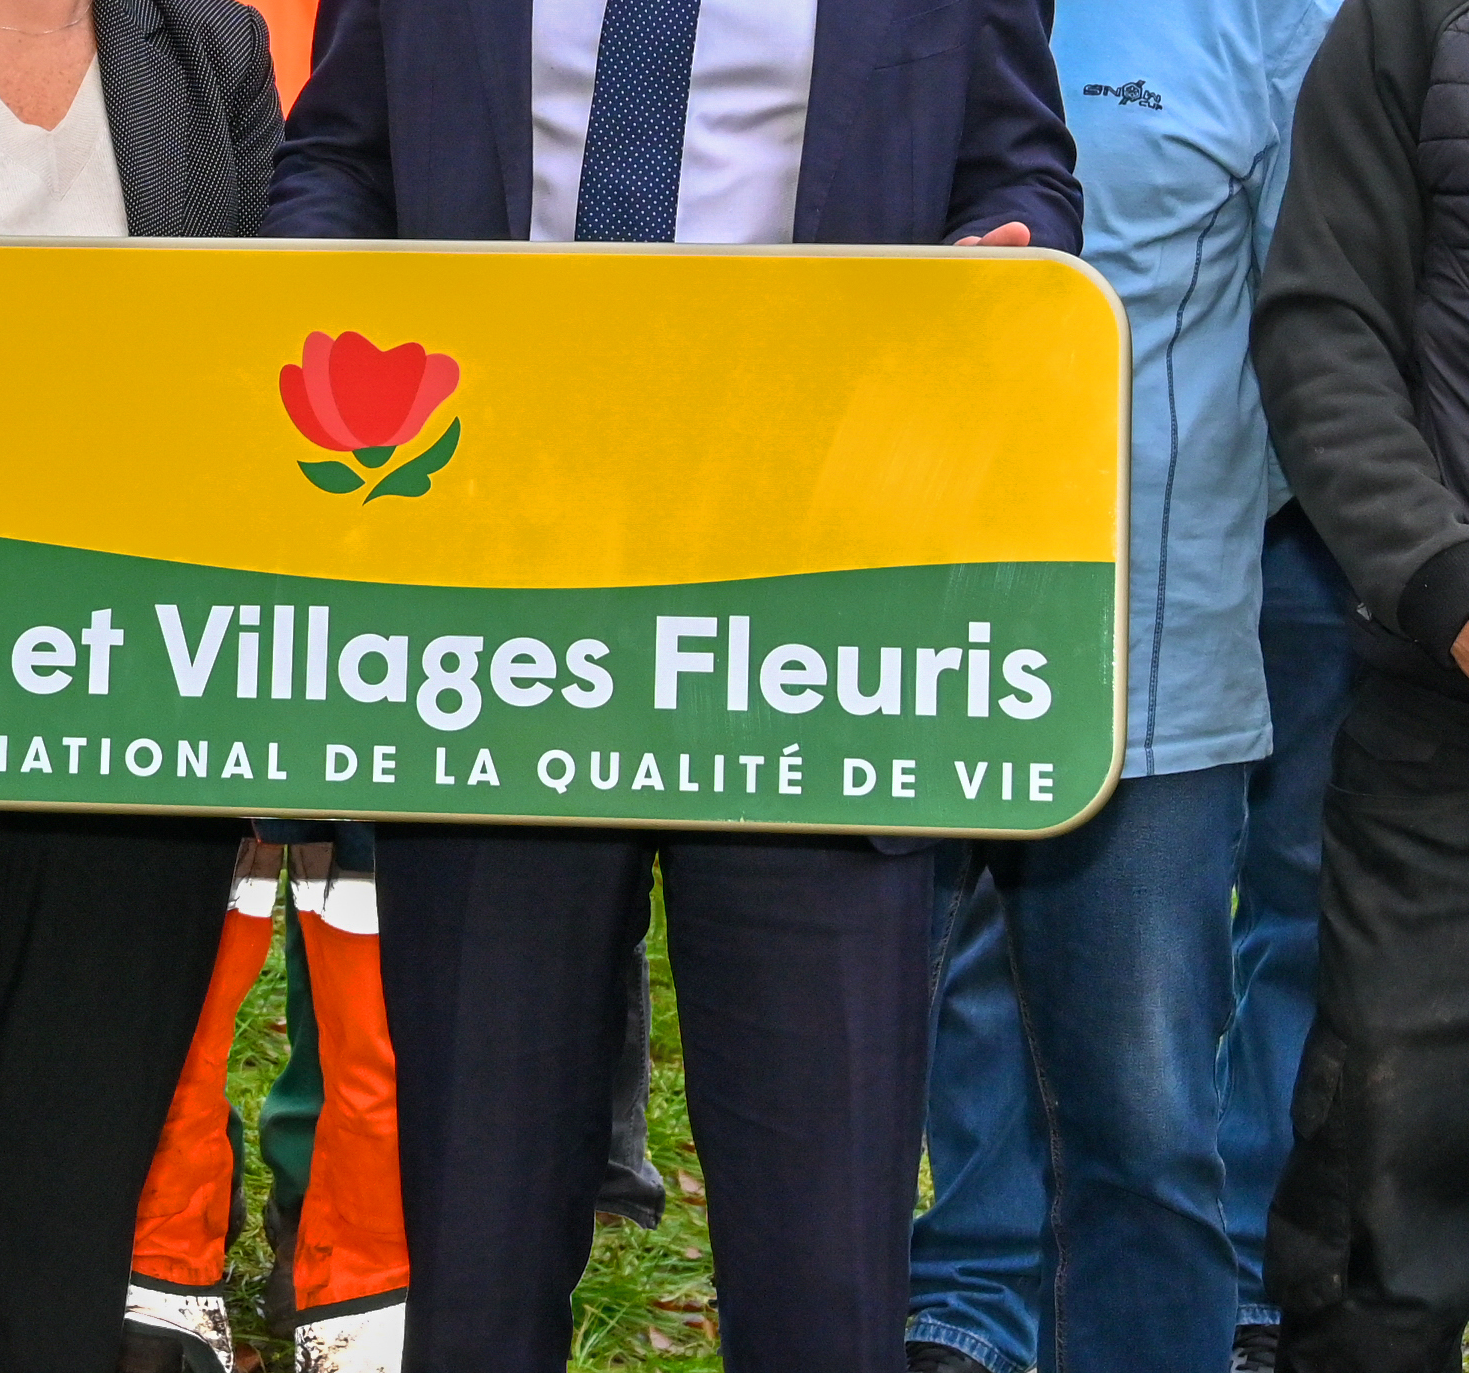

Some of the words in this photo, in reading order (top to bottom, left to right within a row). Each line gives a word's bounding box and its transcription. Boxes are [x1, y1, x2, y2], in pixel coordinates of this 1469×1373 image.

[12, 609, 124, 695] et
[155, 603, 614, 732] Villages
[655, 615, 1052, 720] Fleuris
[325, 743, 397, 783] DE
[435, 746, 501, 787] LA
[536, 742, 803, 795] QUALITÉ
[842, 757, 916, 798] DE
[953, 760, 1054, 802] VIE
